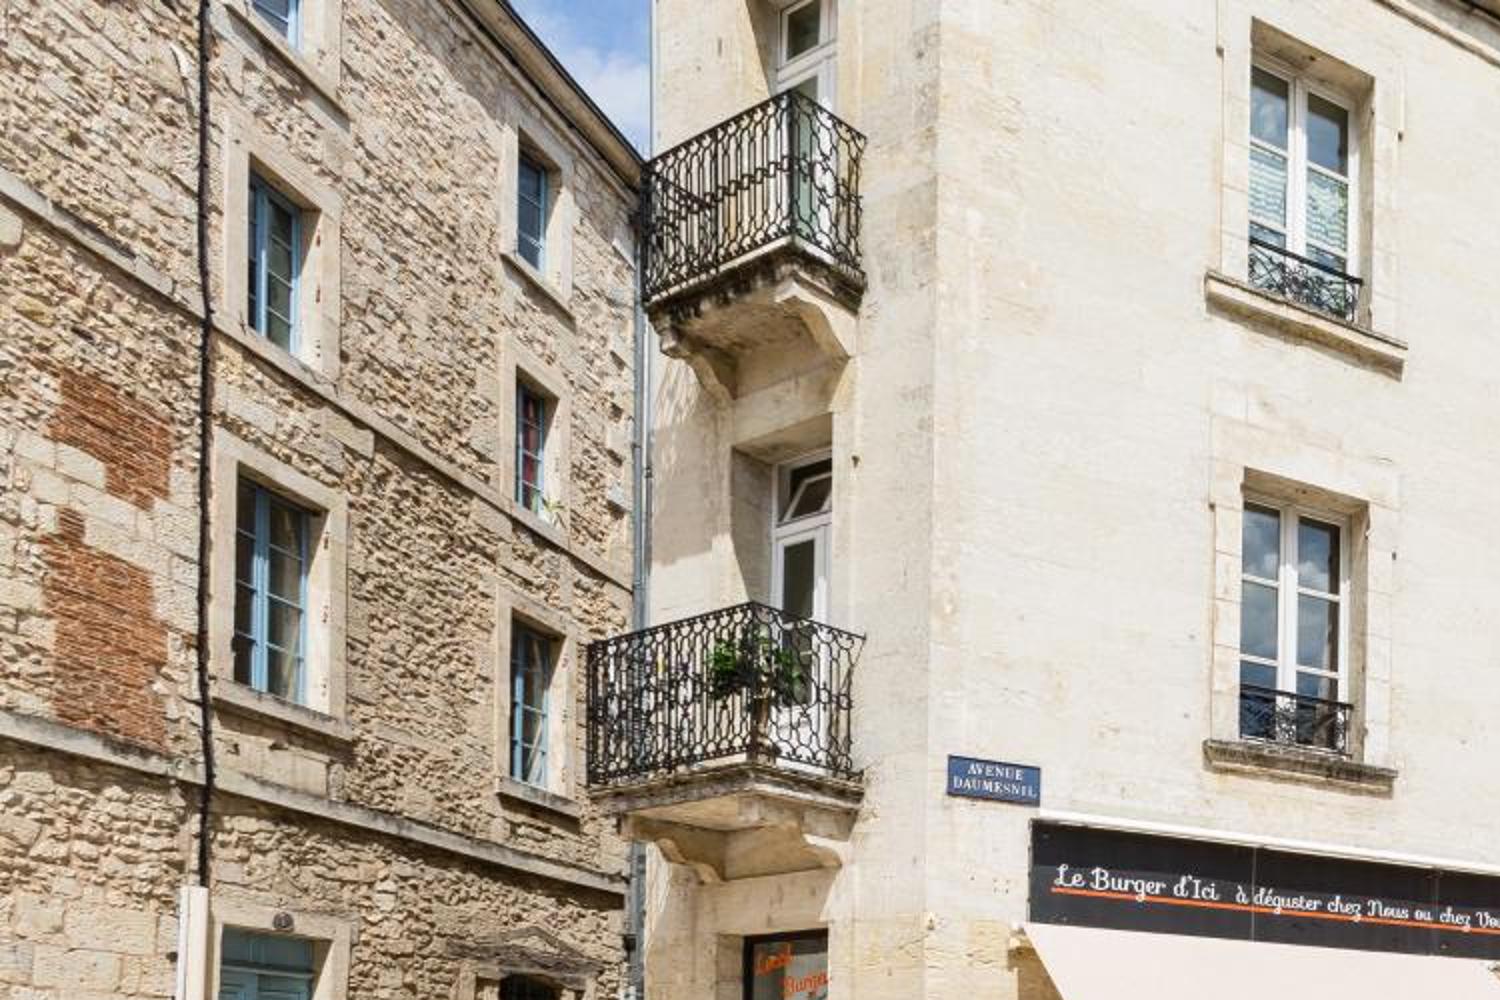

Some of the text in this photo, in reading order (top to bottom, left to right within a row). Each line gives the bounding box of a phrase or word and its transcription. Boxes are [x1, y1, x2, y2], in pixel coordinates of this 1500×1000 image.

[967, 763, 1025, 781] AVENUE
[953, 775, 1037, 799] DAUMESNIL
[1054, 863, 1086, 887] Le
[1090, 867, 1167, 901] Burger
[1173, 875, 1219, 900] d'Ici
[1235, 885, 1248, 903] à
[1253, 887, 1322, 914] déguster
[1327, 895, 1362, 922] chez
[1367, 899, 1409, 919] Nous
[1414, 909, 1432, 921] ou
[1439, 905, 1471, 932] chez
